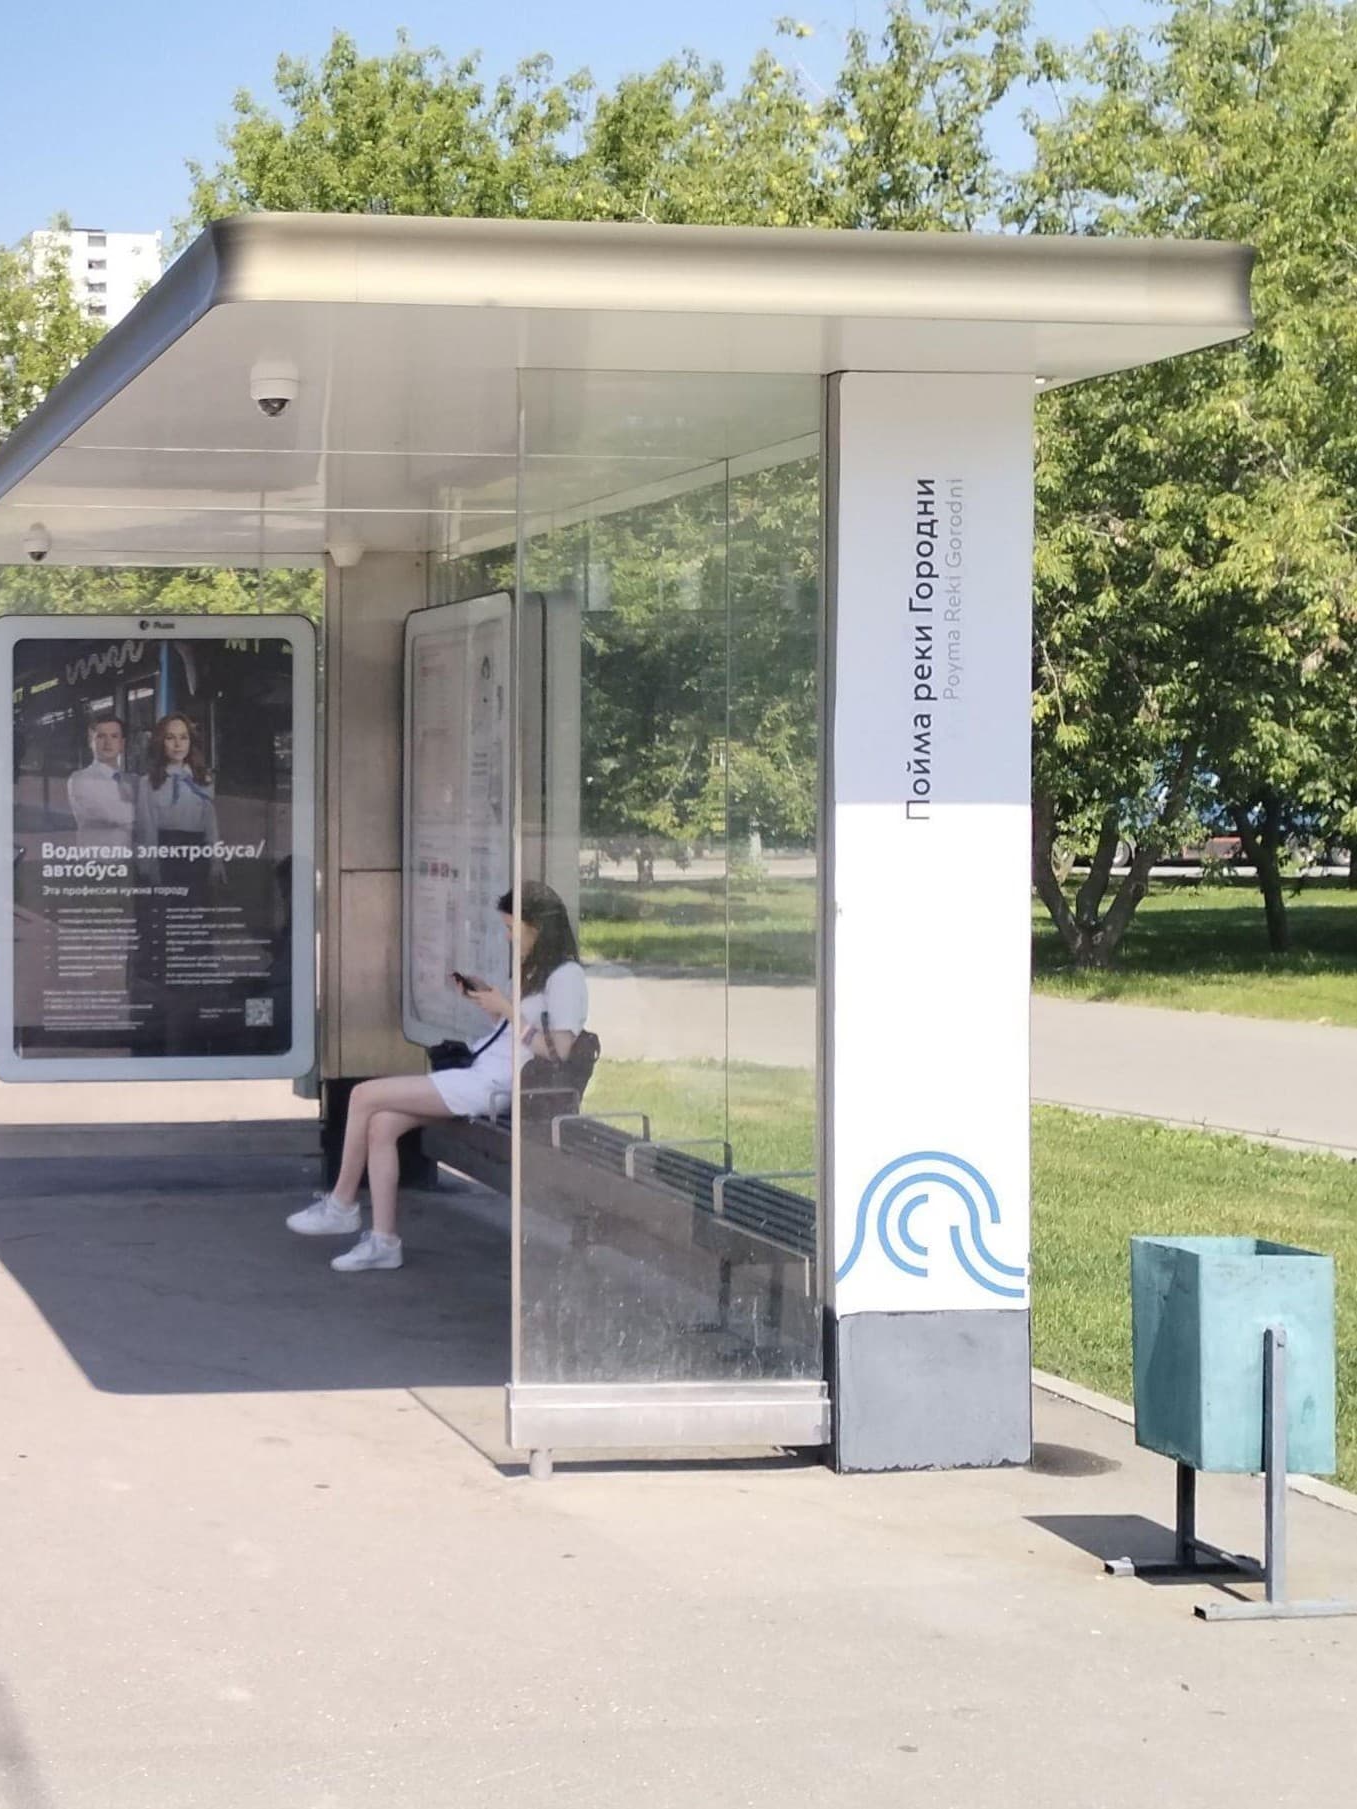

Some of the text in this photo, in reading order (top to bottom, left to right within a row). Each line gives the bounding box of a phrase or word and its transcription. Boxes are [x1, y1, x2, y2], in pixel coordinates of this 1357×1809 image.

[942, 478, 966, 701] Poyma Reki Gorodni
[905, 479, 939, 822] Пойма реки Городни
[41, 839, 266, 862] Водитель электробуса/
[42, 861, 128, 881] автобуса
[42, 885, 61, 896] Эта
[153, 886, 190, 897] городу
